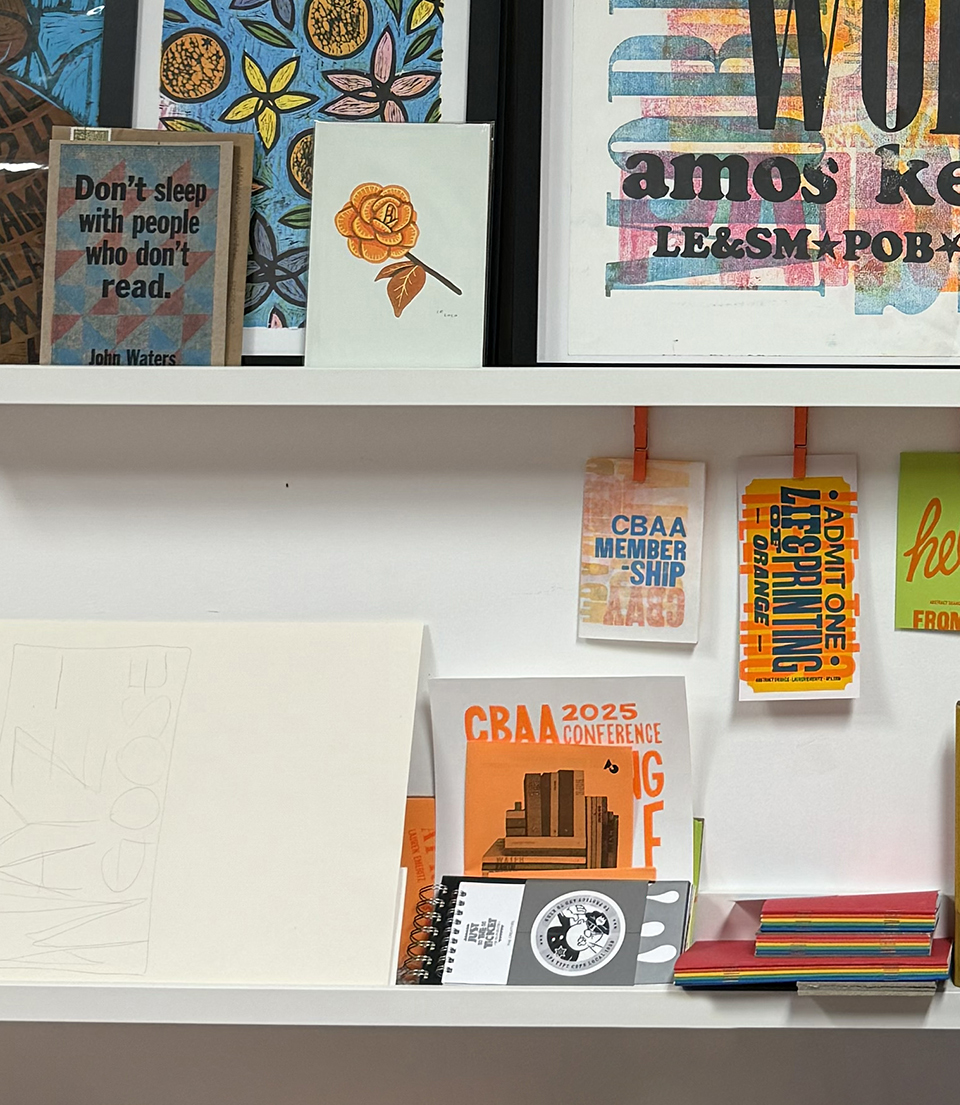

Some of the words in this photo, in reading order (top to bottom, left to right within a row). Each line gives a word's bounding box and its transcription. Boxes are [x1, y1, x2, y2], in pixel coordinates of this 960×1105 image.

[74, 174, 147, 201] Don't
[154, 176, 207, 207] sleep
[621, 151, 840, 206] amos
[79, 207, 124, 233] with
[132, 209, 200, 239] people
[86, 240, 127, 265] who
[136, 240, 189, 266] don't
[101, 273, 171, 298] read.
[88, 349, 121, 366] John
[126, 349, 177, 366] Waters
[611, 515, 687, 537] CBAA
[770, 505, 781, 553] OF
[595, 537, 686, 561] MEMBER
[823, 506, 846, 589] ADMIT
[752, 534, 770, 627] ORANGE
[771, 555, 823, 673] PRINTING
[824, 593, 846, 651] ONE
[464, 704, 560, 743] CBAA
[562, 703, 638, 721] 2025
[563, 723, 663, 744] CONFERENCE
